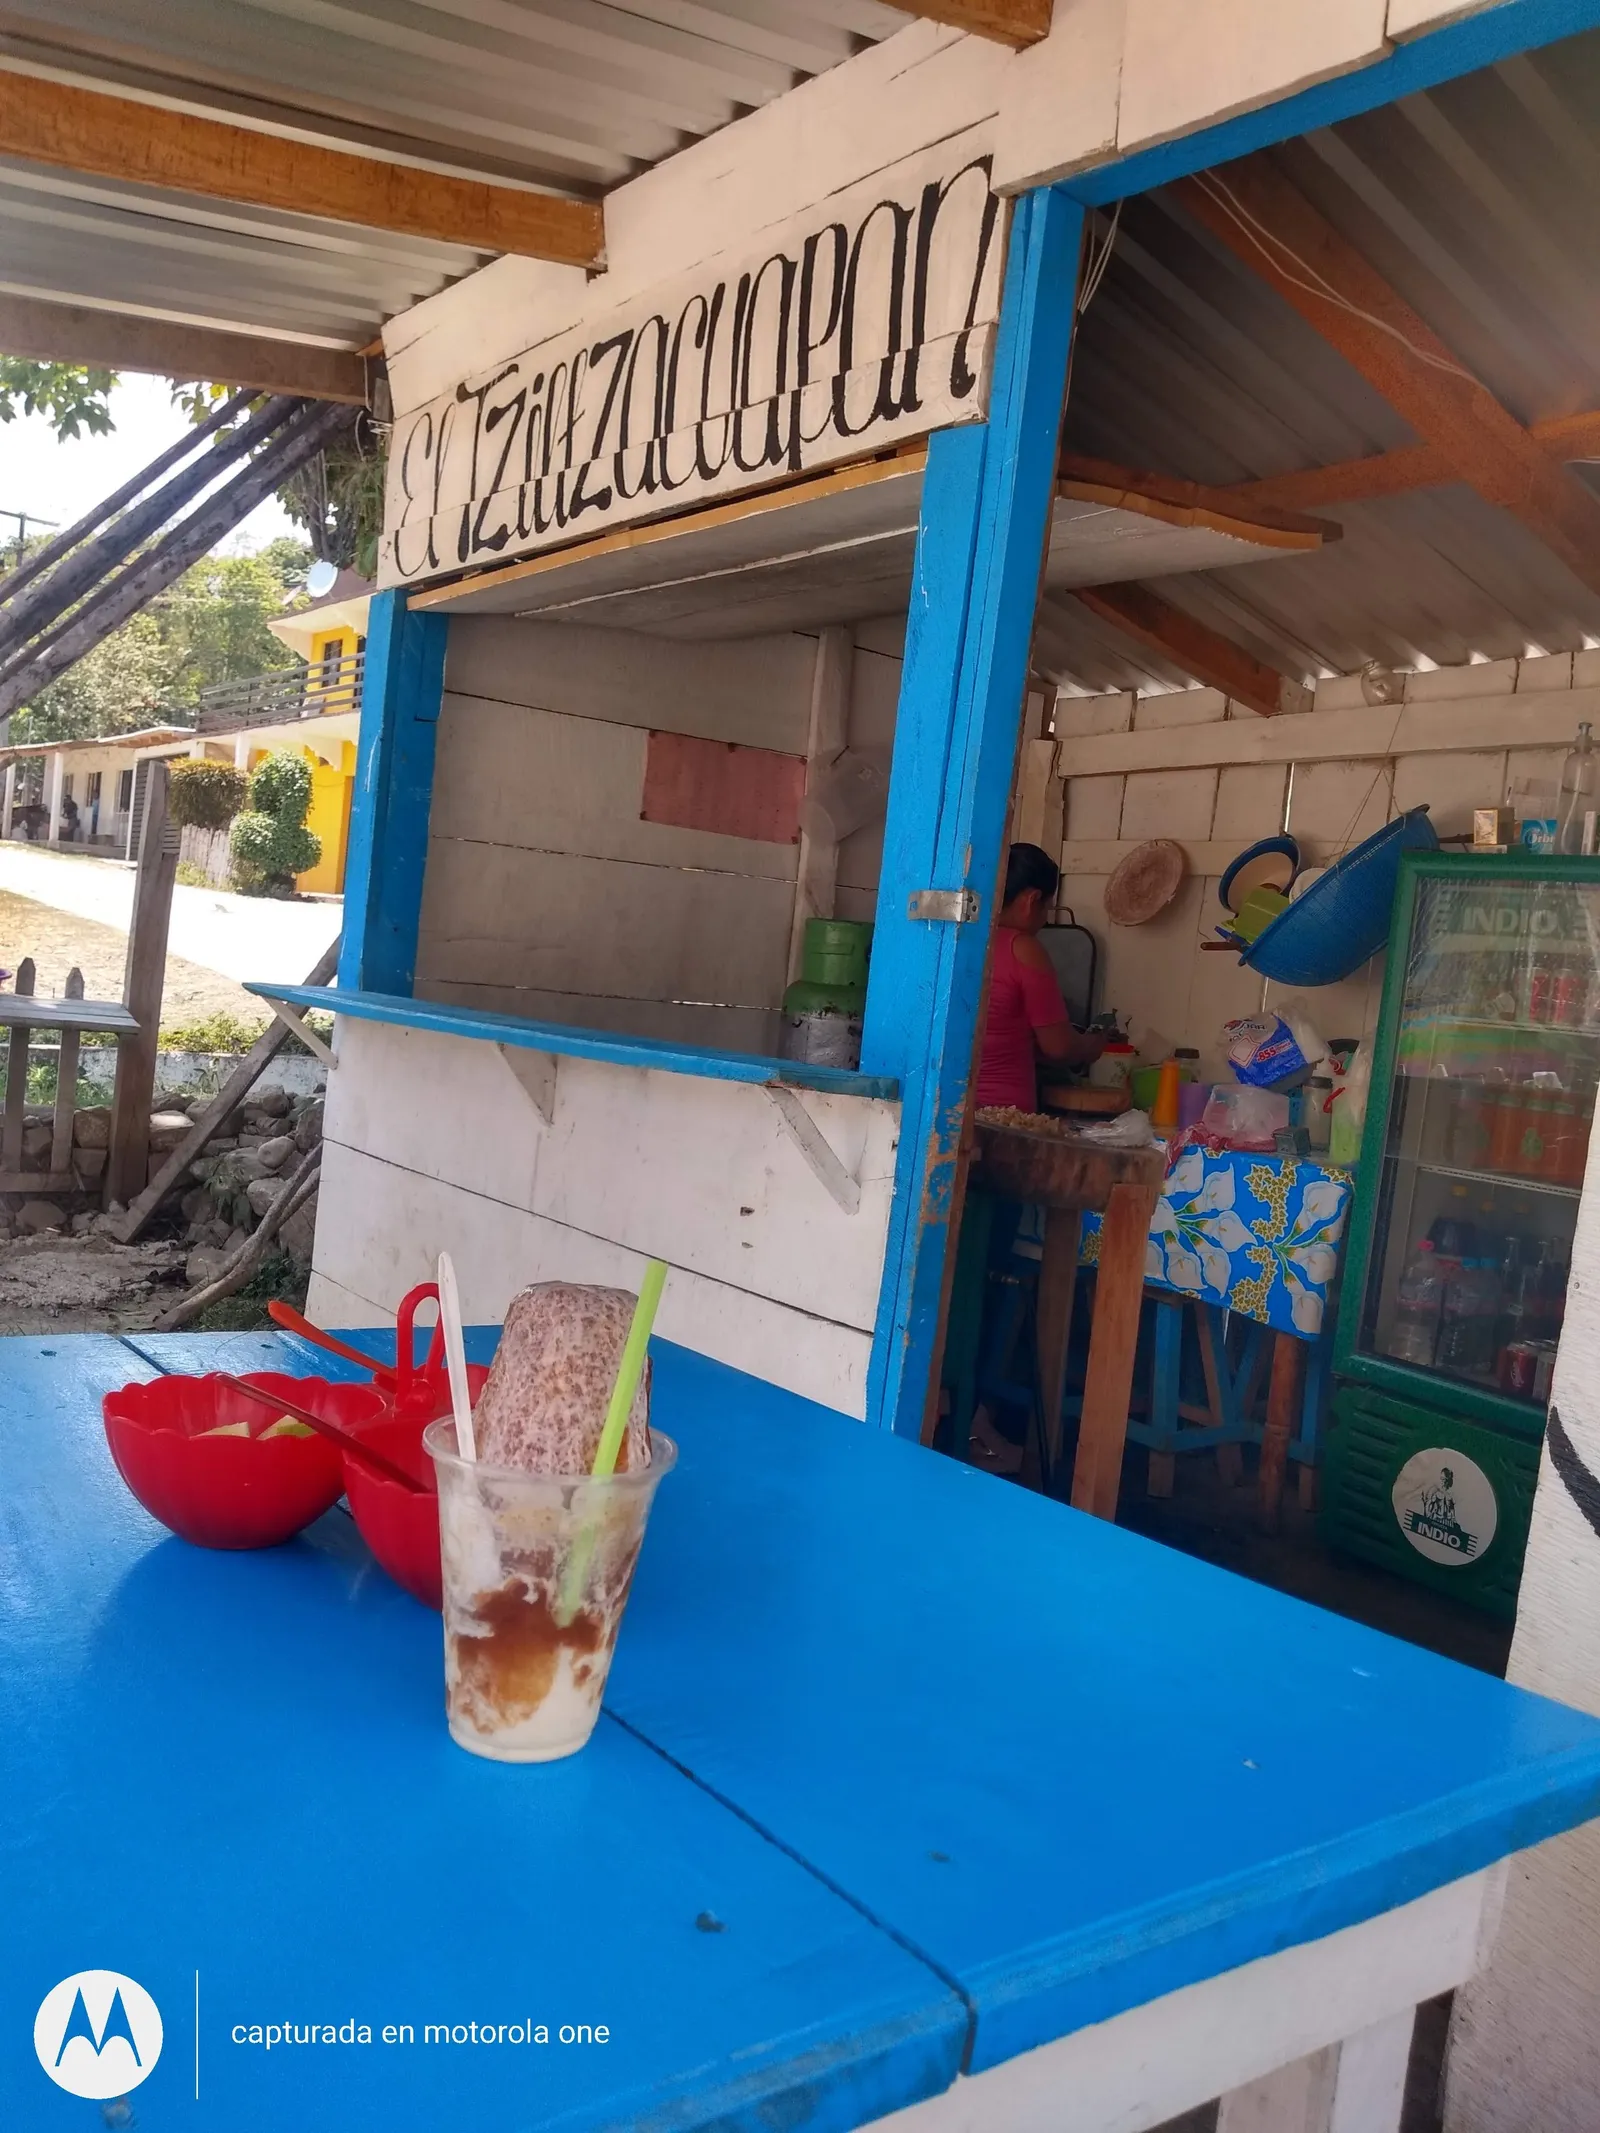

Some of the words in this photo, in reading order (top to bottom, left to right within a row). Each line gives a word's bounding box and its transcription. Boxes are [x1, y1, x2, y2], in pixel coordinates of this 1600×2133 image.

[394, 402, 456, 577] El
[1463, 906, 1559, 935] INDIO
[1417, 1521, 1461, 1548] INDIO
